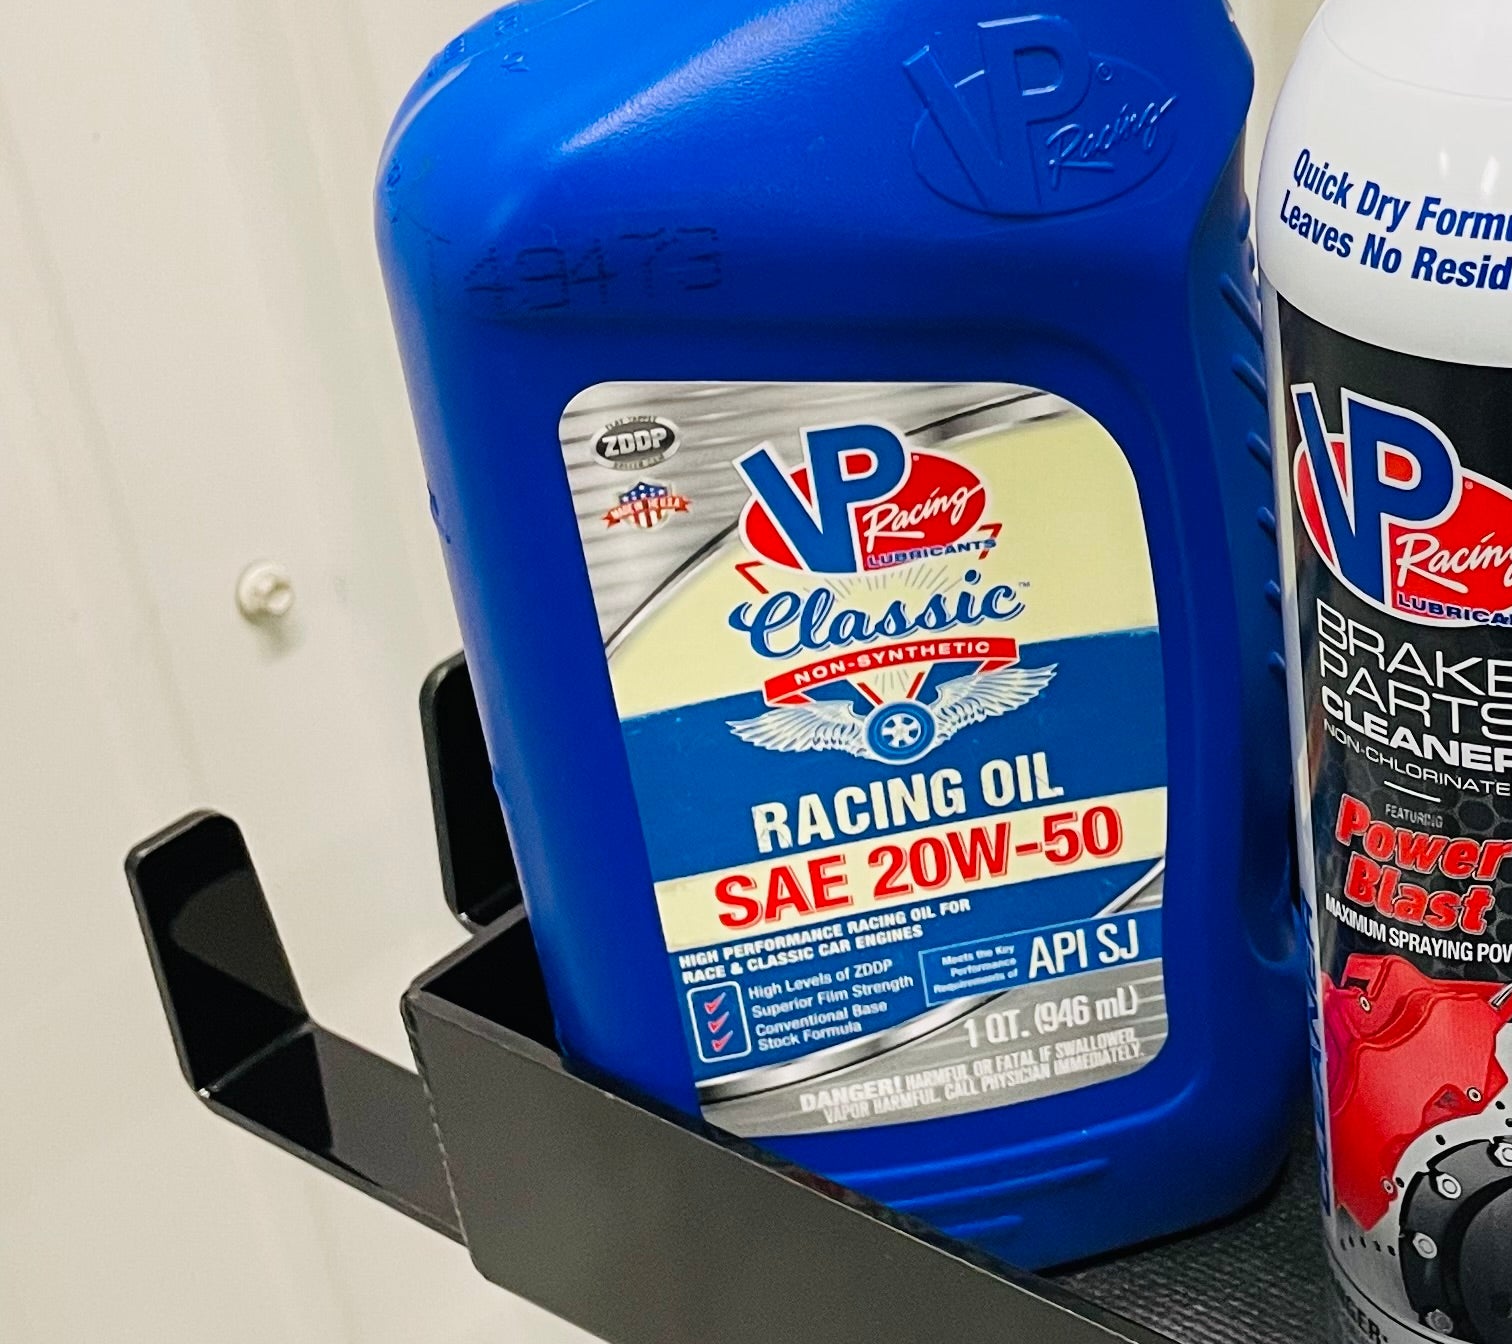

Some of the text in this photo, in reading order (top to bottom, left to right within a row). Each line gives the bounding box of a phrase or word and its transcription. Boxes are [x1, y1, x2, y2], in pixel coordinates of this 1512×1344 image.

[1293, 148, 1355, 209] Quick
[1356, 180, 1411, 233] Dry
[1280, 189, 1354, 258] Leaves
[1359, 232, 1402, 274] No
[601, 427, 668, 458] ZDDP
[737, 424, 983, 574] VP Racing
[1292, 386, 1457, 604] VP
[868, 538, 998, 569] LUBRICANTS
[728, 569, 1026, 661] Classic
[793, 641, 991, 686] NON-SYNTHETIC
[752, 752, 1064, 853] RACING OIL
[1385, 803, 1444, 829] FEATURING
[714, 806, 1123, 930] SAE 20W-50
[1344, 851, 1496, 935] Blast
[679, 898, 971, 969] HIGH PERFORMANCE RACING OIL FOR
[682, 925, 924, 985] RACE & CLASSIC CAR ENGINES
[1029, 919, 1140, 979] API SJ
[1325, 892, 1387, 944] MAXIMUM
[1388, 924, 1474, 963] SPRAYING
[748, 959, 893, 1002] High Levels of ZDDP
[752, 976, 914, 1020] Superior Film Strength
[755, 1000, 888, 1037] Conventional Base
[758, 1021, 862, 1052] Stock Formula
[964, 985, 1140, 1048] 1 QT. (946 mL)
[799, 1076, 904, 1113] DANGER!
